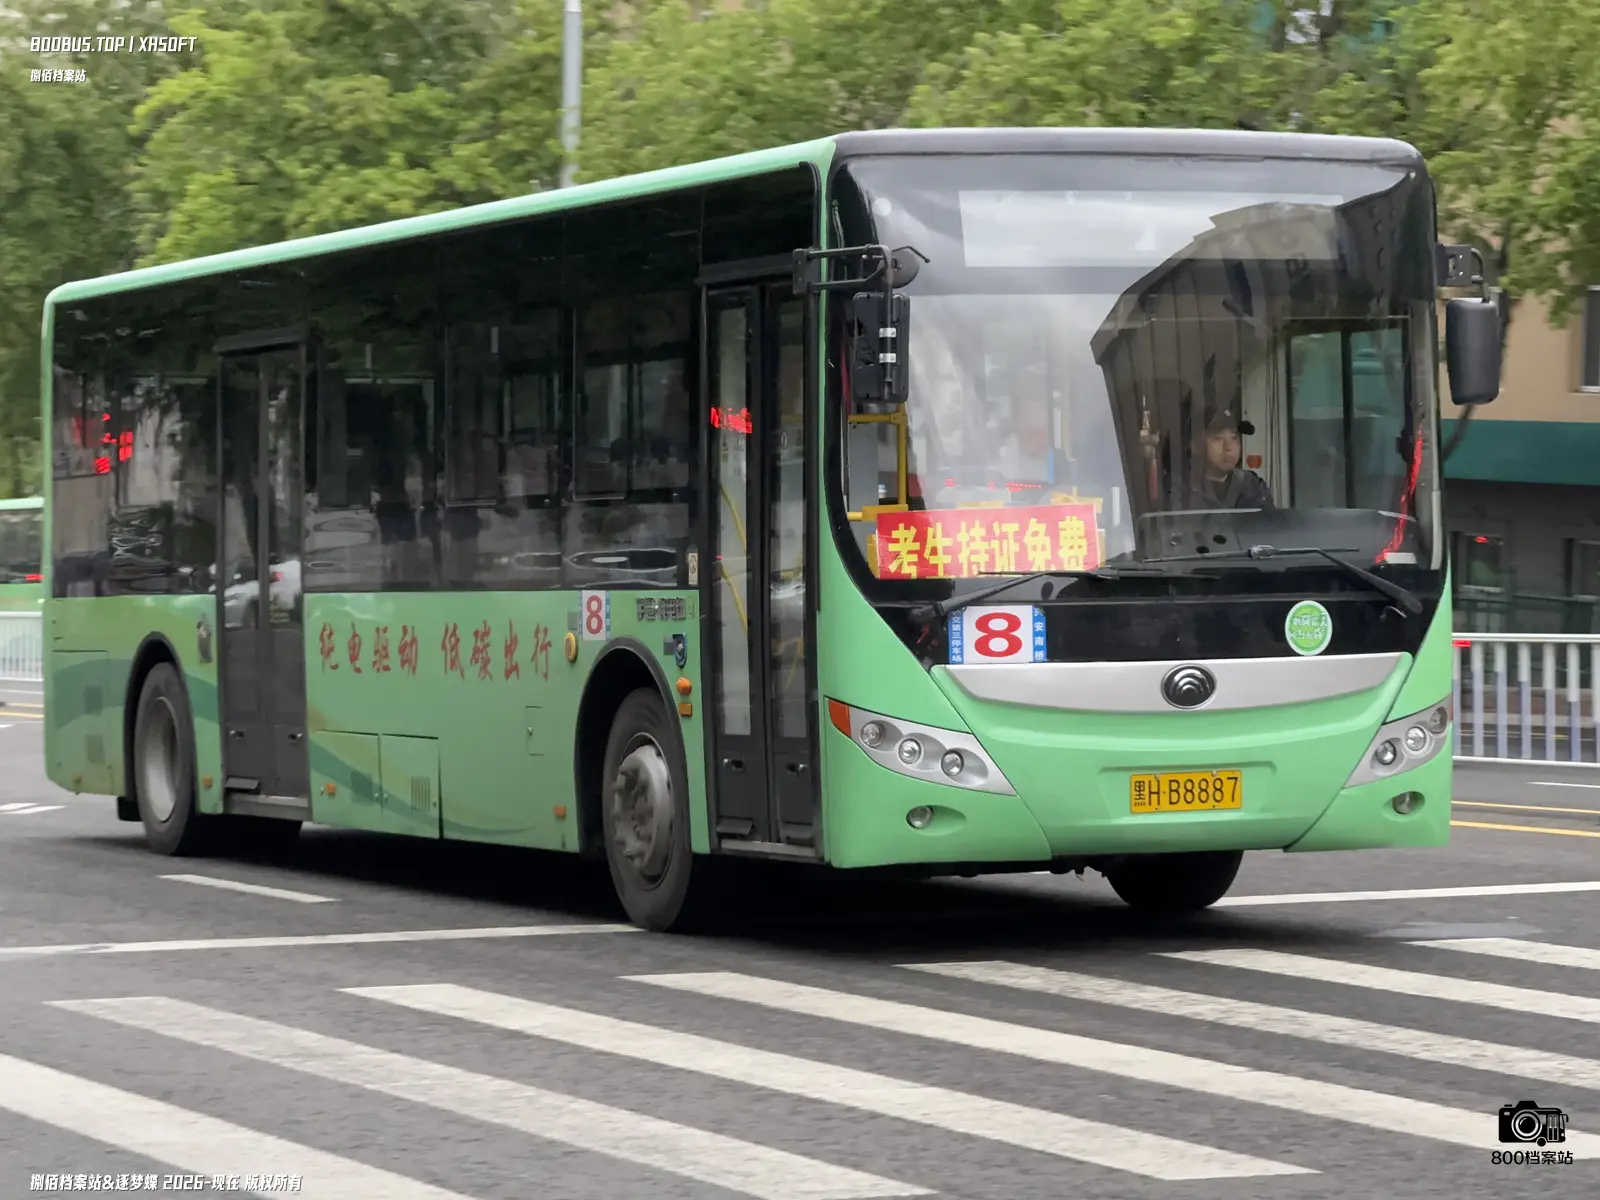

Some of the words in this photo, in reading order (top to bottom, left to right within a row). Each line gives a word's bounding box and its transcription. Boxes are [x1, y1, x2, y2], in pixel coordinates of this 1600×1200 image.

[888, 515, 1088, 579] 考生持证免费
[586, 595, 603, 635] 8
[974, 612, 1023, 658] 8
[319, 622, 418, 676] 纯电驱动
[441, 618, 552, 682] 低碳出行
